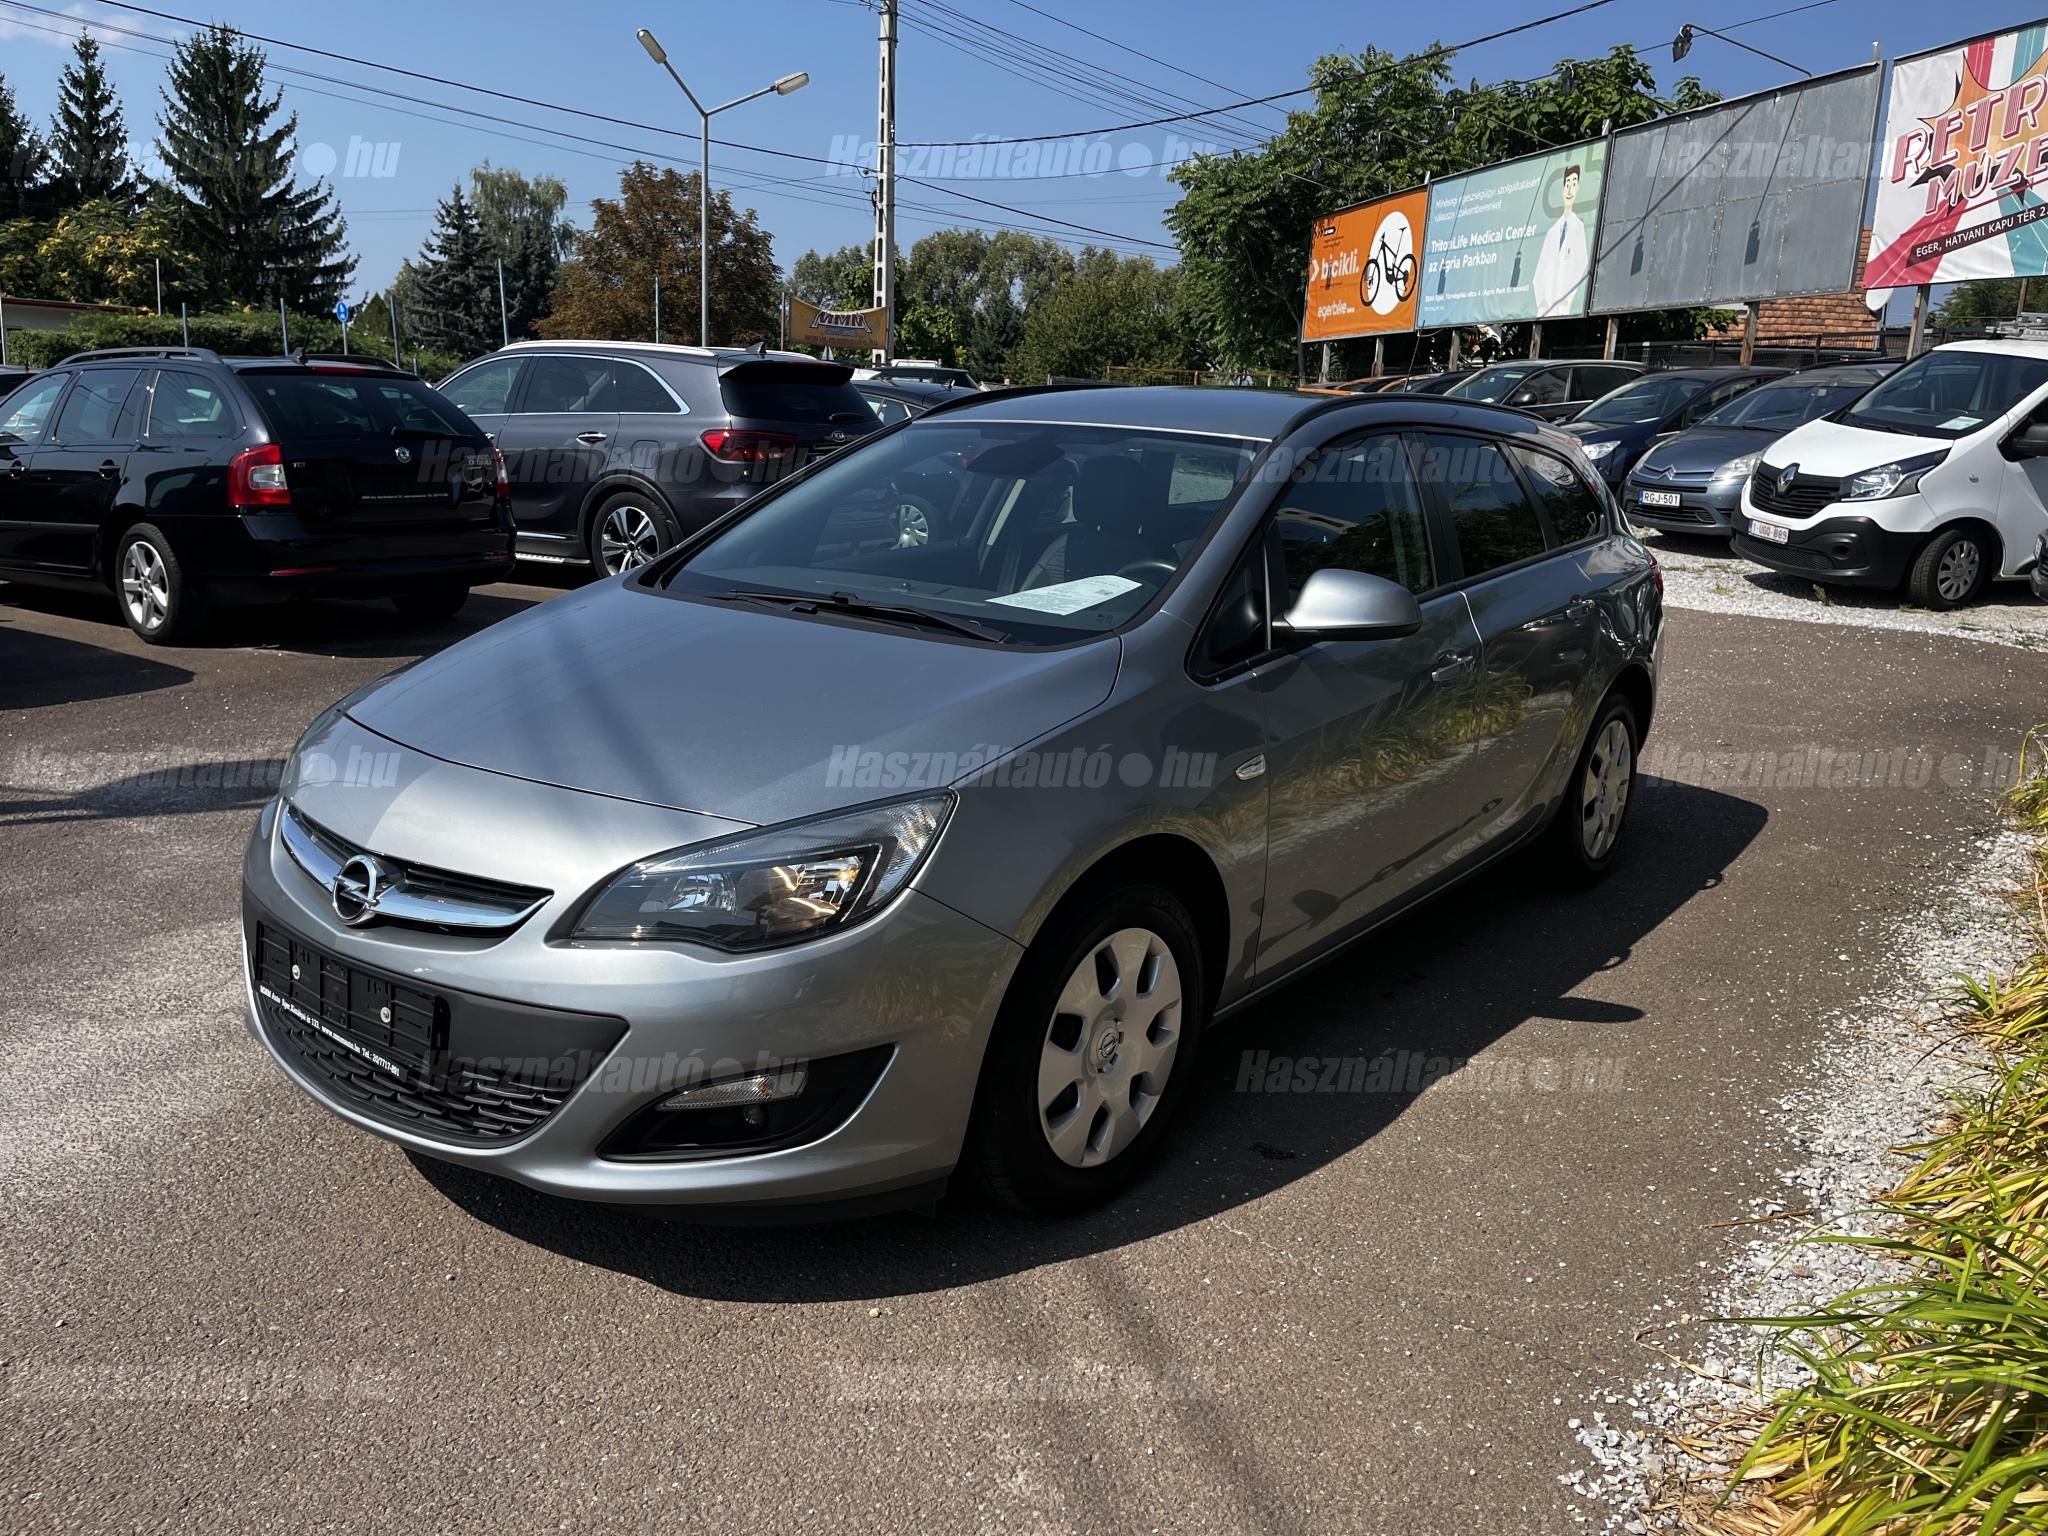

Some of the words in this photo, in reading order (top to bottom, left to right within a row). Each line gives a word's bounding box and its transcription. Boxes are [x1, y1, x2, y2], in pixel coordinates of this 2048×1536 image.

[1891, 74, 2048, 184] RETR
[1470, 227, 1504, 246] Medical
[1505, 224, 1537, 240] Center
[1916, 242, 1942, 257] EGER,
[1945, 226, 1985, 247] HATVANI
[1988, 217, 2014, 233] KAPU
[2017, 209, 2036, 223] TÉR
[1428, 262, 1437, 273] az
[1439, 255, 1460, 273] Agria
[1462, 252, 1497, 268] Parkban
[1644, 492, 1679, 505] RGJ-501
